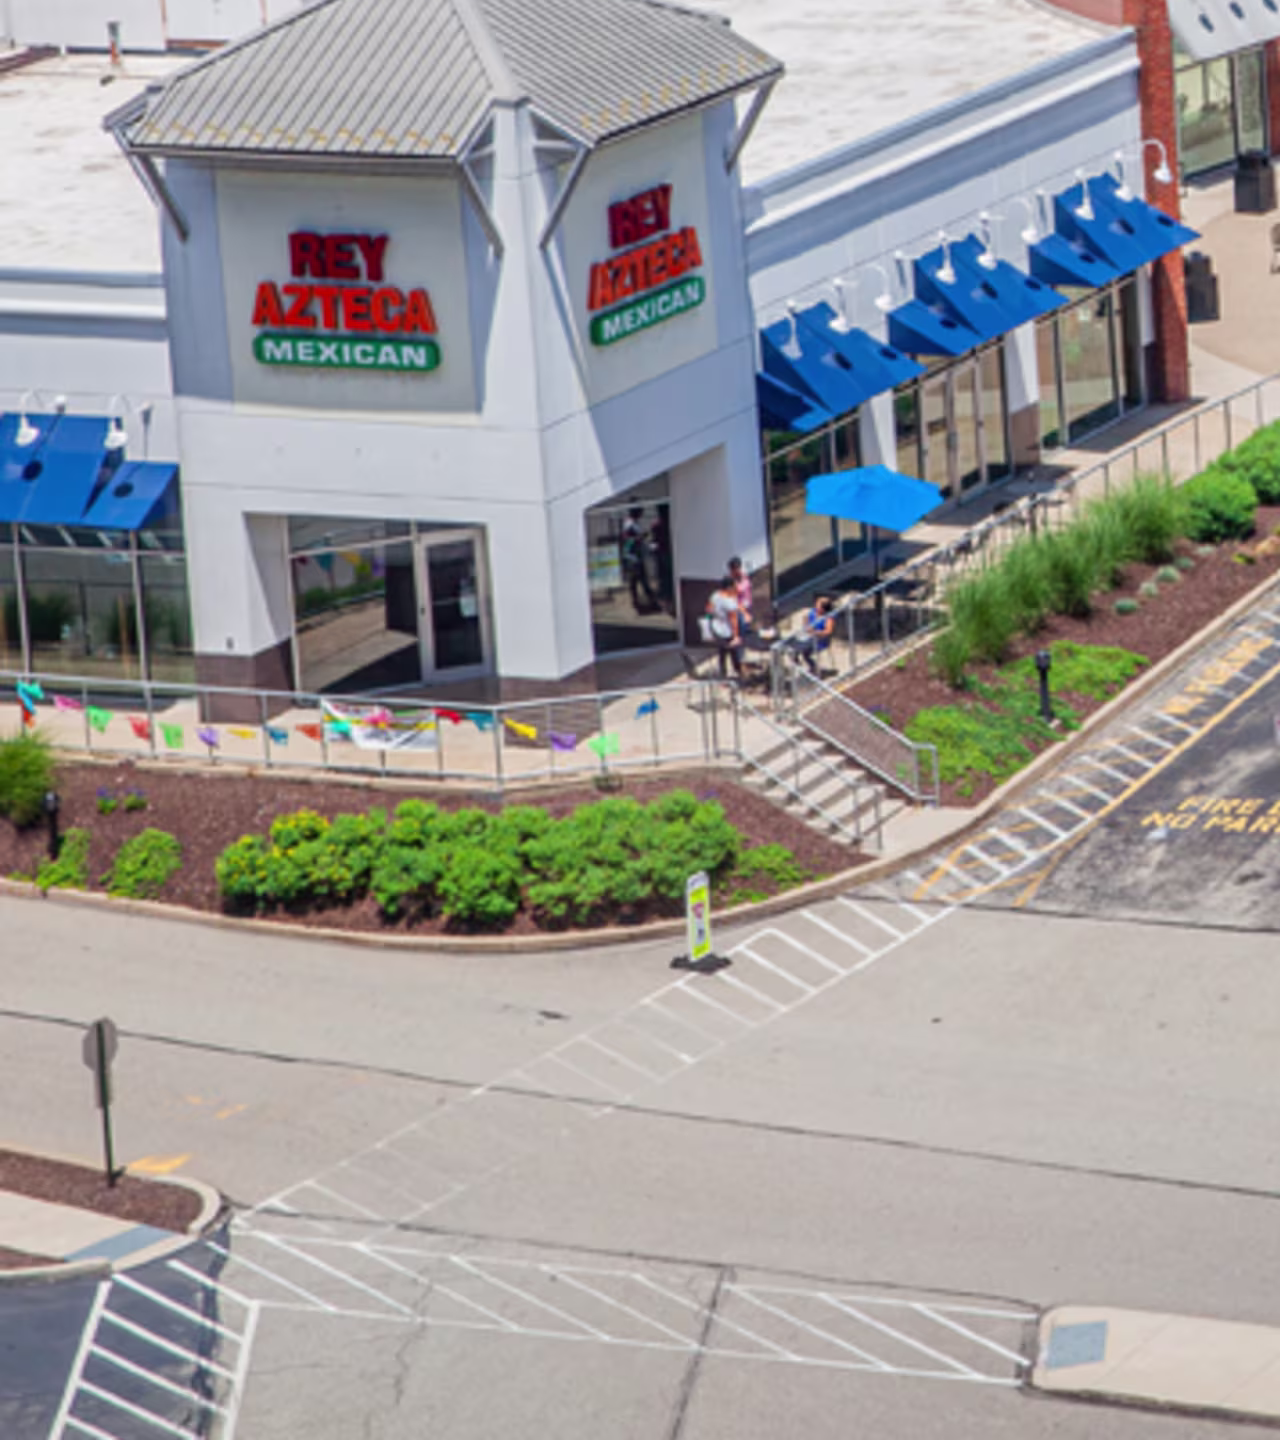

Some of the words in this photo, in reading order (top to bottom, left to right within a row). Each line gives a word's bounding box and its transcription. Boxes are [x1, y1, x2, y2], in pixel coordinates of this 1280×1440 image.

[607, 182, 674, 249] REY
[287, 230, 390, 282] REY
[587, 225, 704, 311] AZTECA
[251, 280, 439, 335] AZTECA
[601, 283, 700, 341] MEXICAN
[263, 338, 427, 367] MEXICAN
[1141, 812, 1197, 828] NO
[1178, 796, 1263, 813] FIRE
